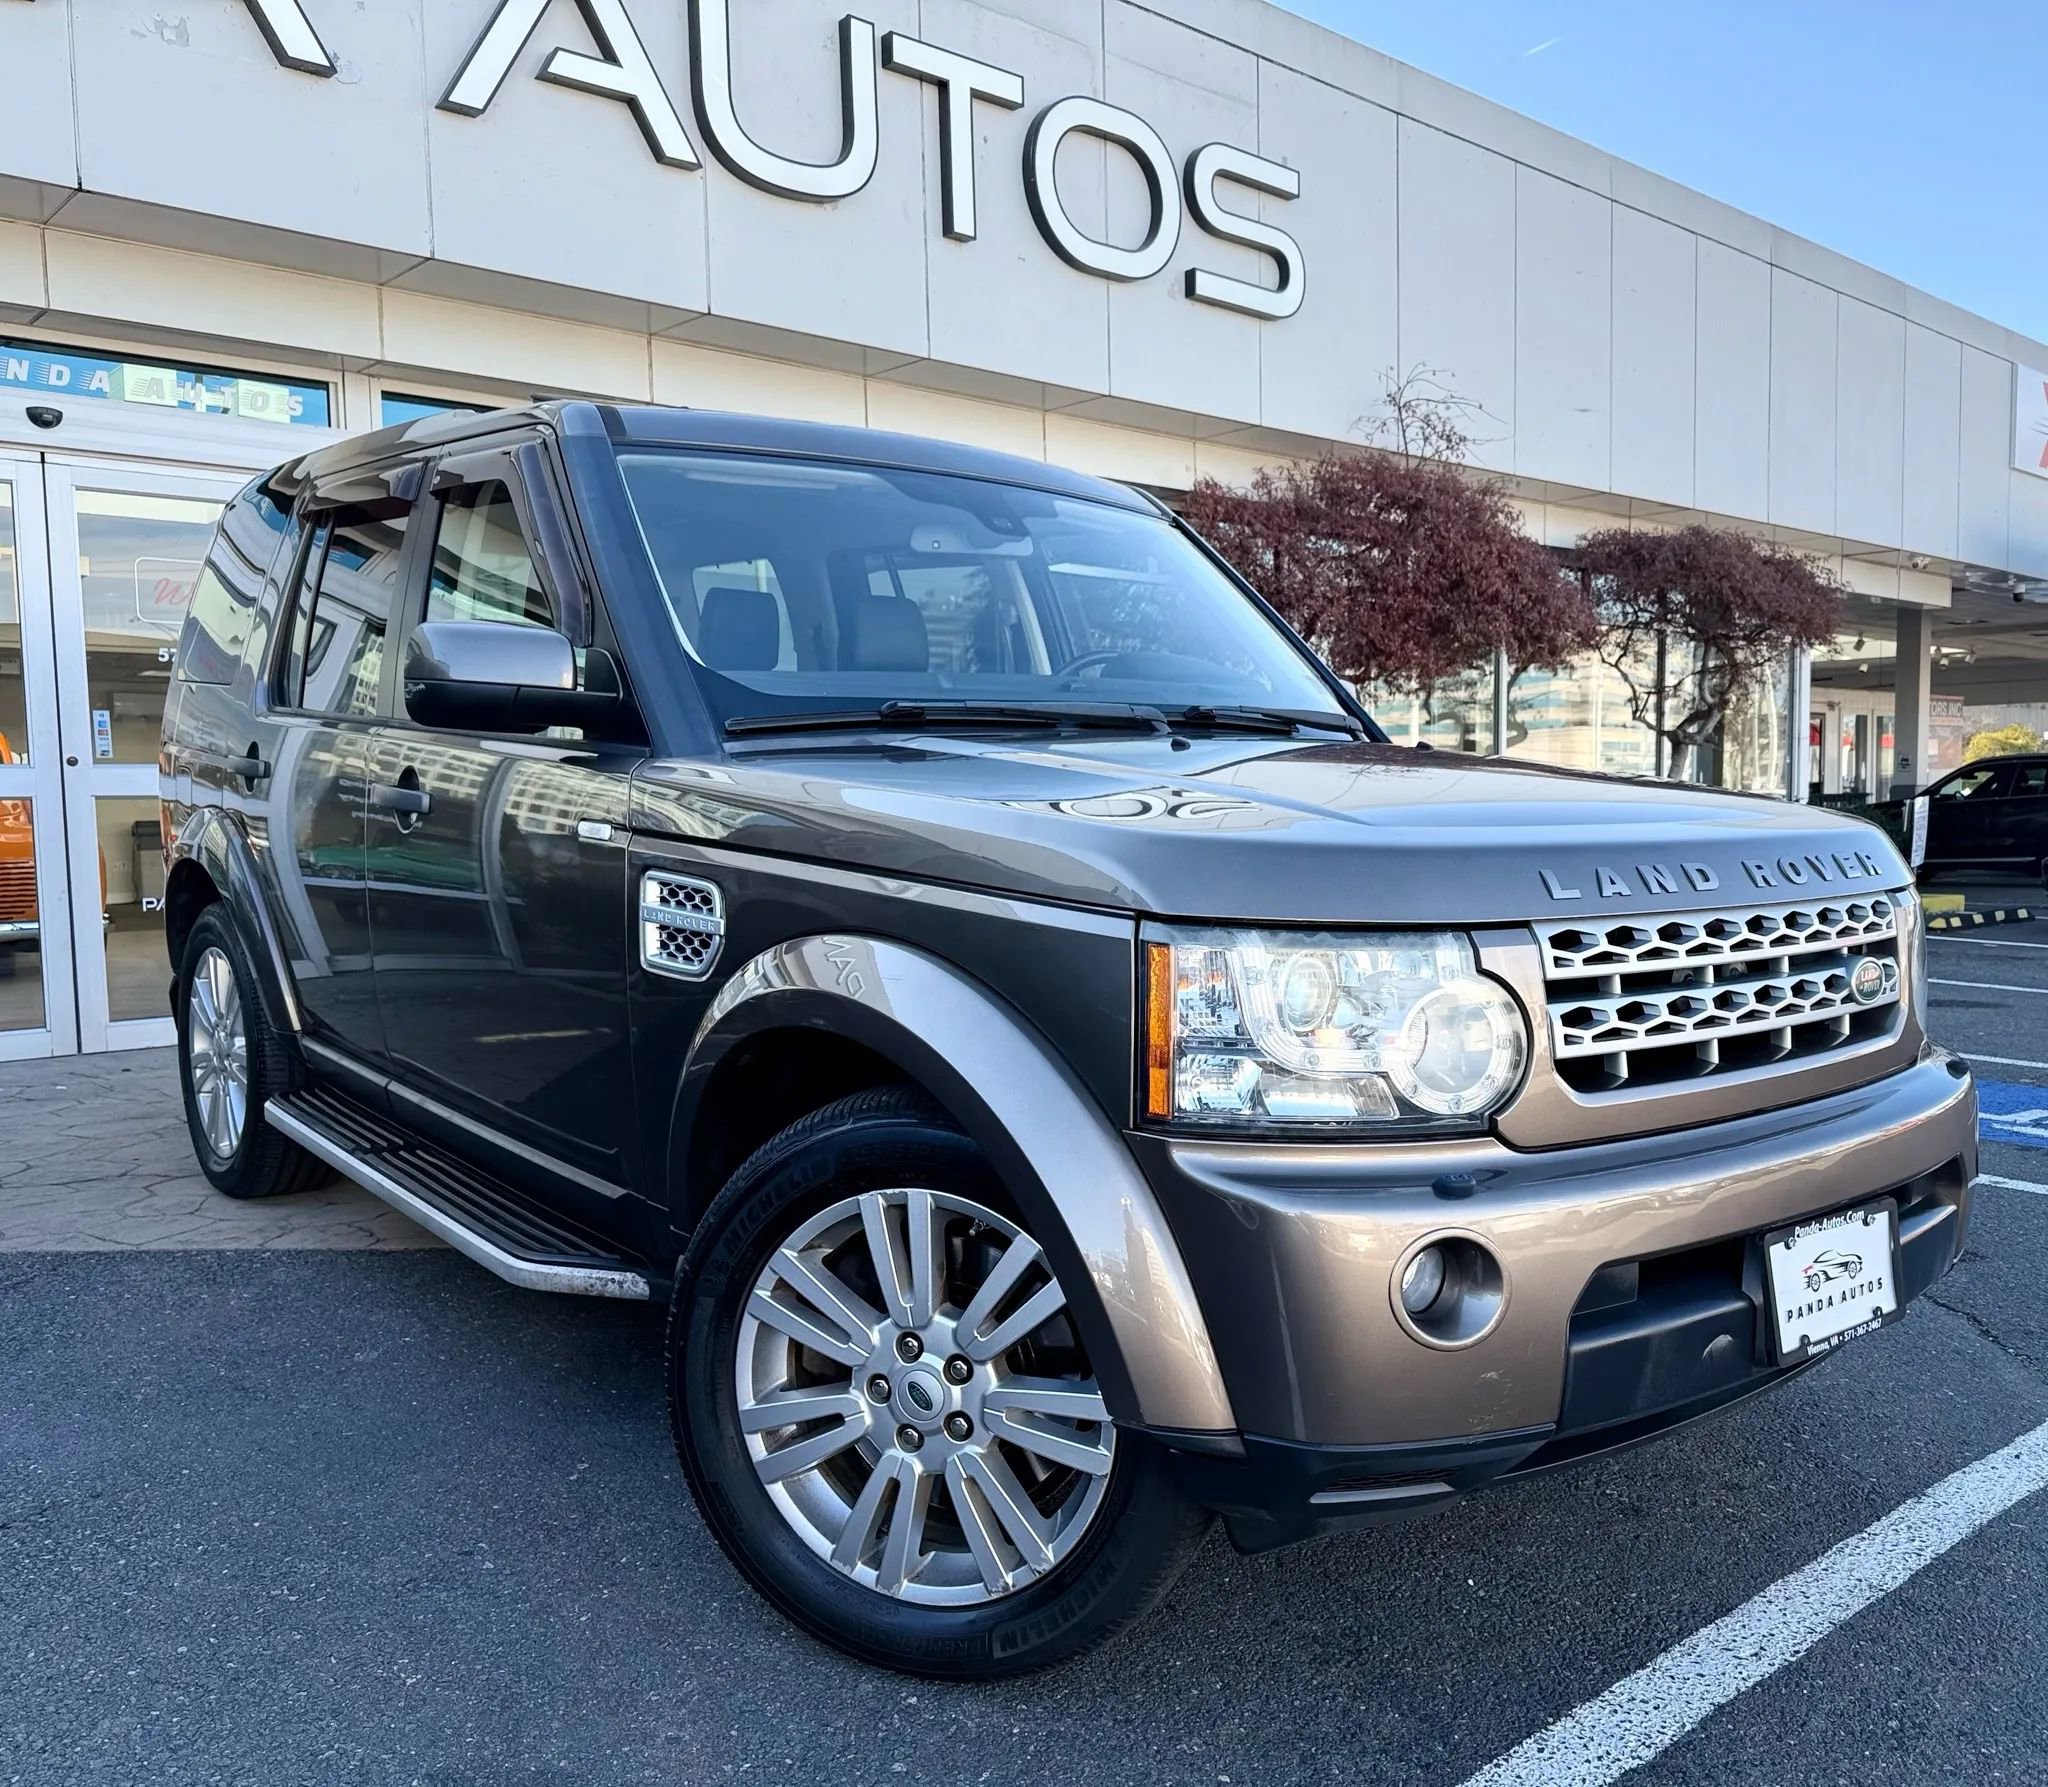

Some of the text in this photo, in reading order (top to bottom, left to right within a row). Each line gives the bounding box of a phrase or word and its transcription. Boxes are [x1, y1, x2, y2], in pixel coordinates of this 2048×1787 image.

[437, 0, 1305, 320] AUTOS
[1539, 850, 1883, 900] LAND ROVER
[642, 908, 715, 932] LAND ROVER
[1794, 1210, 1865, 1238] Panda-Autos.Com
[1786, 1277, 1883, 1323] PANDA AUTOS
[1844, 1318, 1883, 1341] 571-367-2467
